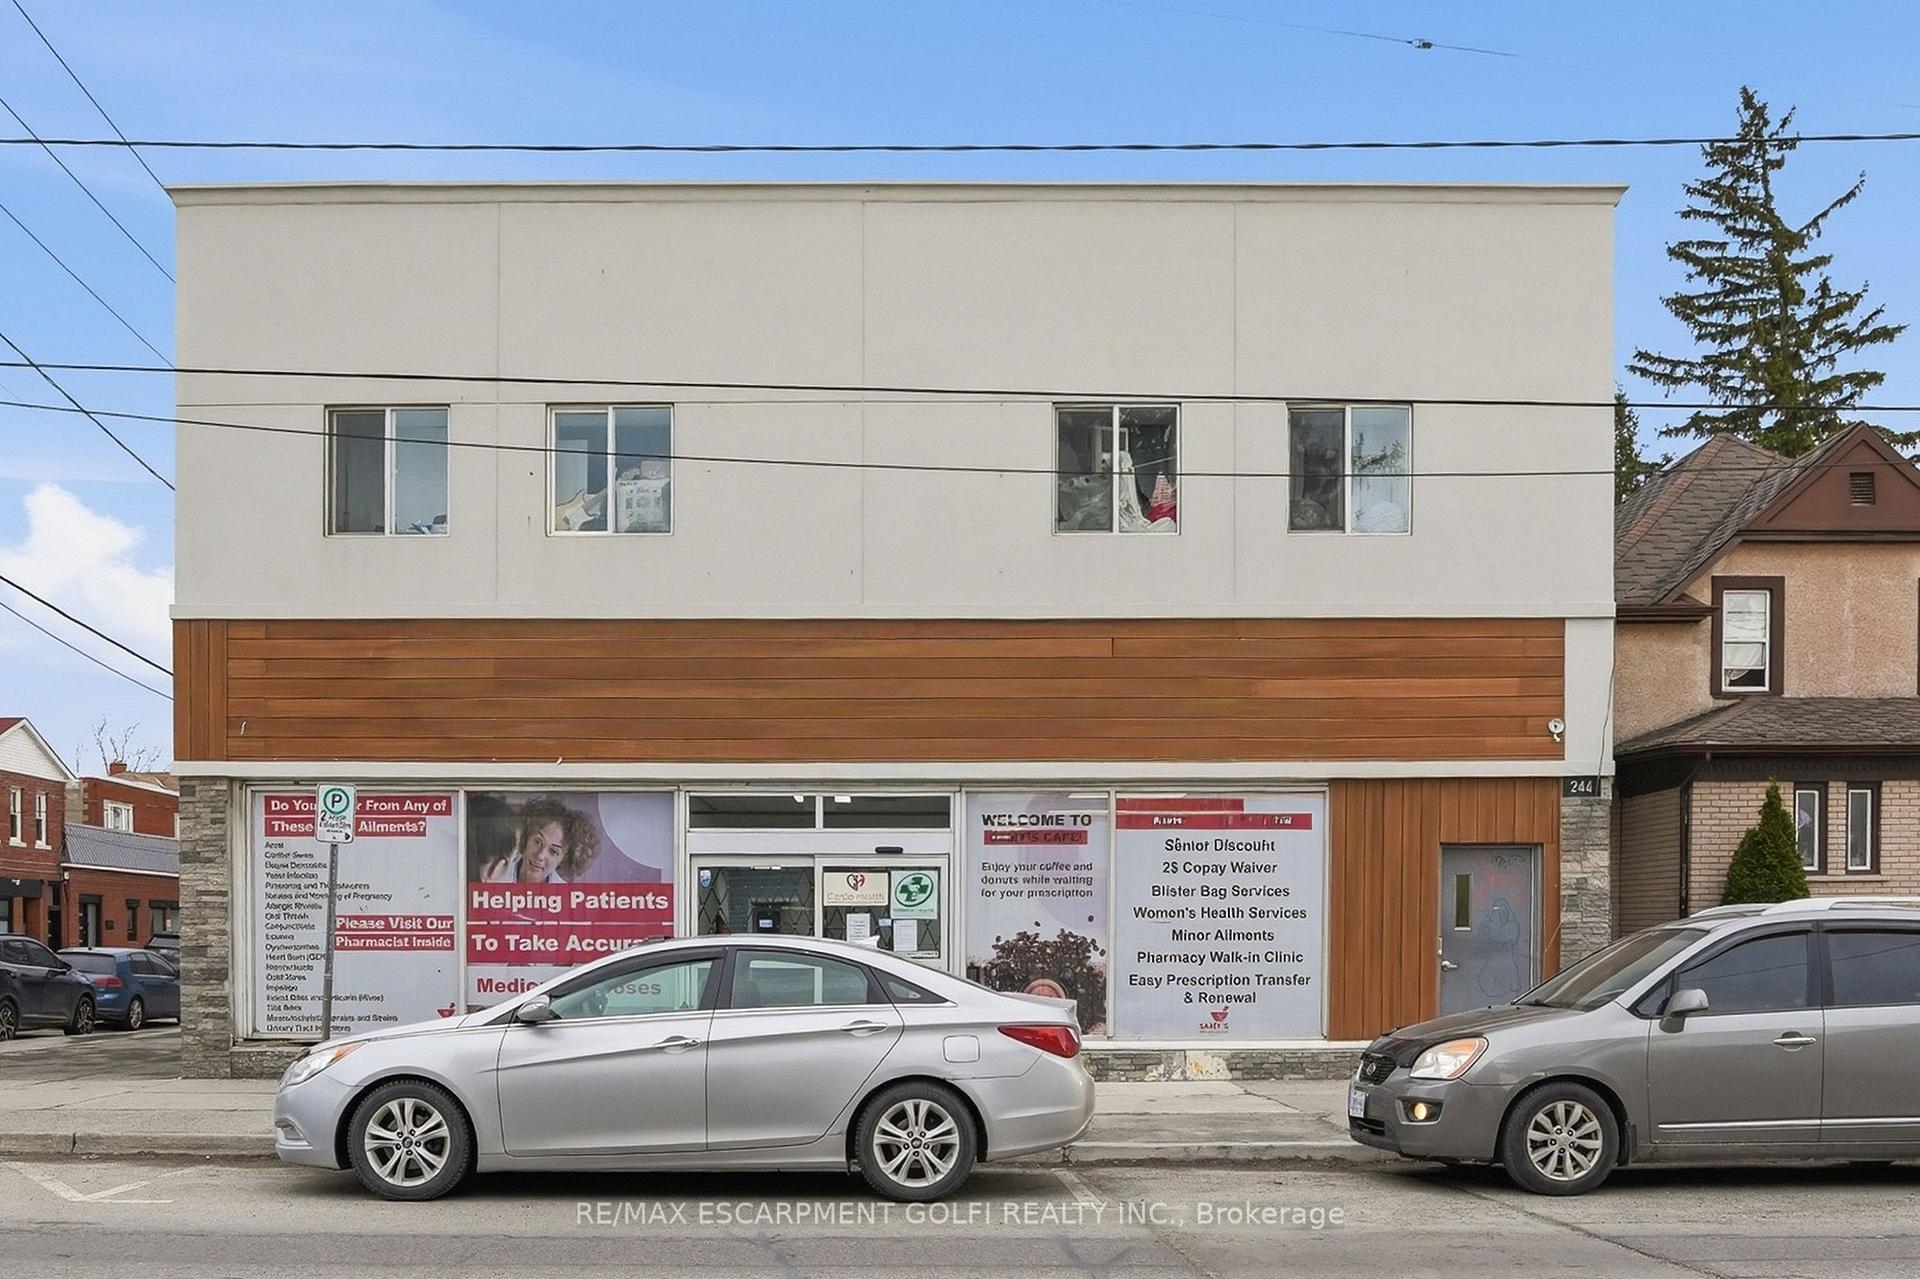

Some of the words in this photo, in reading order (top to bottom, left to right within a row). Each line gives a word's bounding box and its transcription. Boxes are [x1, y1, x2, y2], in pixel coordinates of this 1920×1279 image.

[1570, 780, 1593, 793] 244
[271, 801, 288, 811] Do
[366, 801, 400, 811] From
[403, 800, 430, 814] Any
[433, 800, 447, 811] of
[271, 821, 314, 832] These
[358, 820, 426, 832] Ailments?
[982, 814, 1065, 826] WELCOME
[1069, 814, 1092, 826] TO
[981, 862, 1011, 873] Enjoy
[1014, 863, 1037, 873] your
[1073, 862, 1093, 872] and
[1182, 861, 1227, 876] Copay
[1231, 861, 1278, 874] Waiver
[981, 876, 1019, 885] donuts
[1022, 876, 1051, 885] while
[981, 888, 997, 898] for
[1000, 890, 1024, 900] your
[1151, 885, 1196, 898] Blister
[1200, 885, 1227, 900] Bag
[1231, 885, 1290, 898] Services
[472, 891, 562, 912] Helping
[570, 891, 669, 910] Patients
[1248, 906, 1307, 919] Services
[336, 917, 385, 930] Please
[388, 917, 421, 930] Visit
[426, 917, 453, 930] Our
[1171, 928, 1211, 941] Minor
[336, 935, 409, 948] Pharmacist
[412, 935, 451, 948] Inside
[471, 934, 498, 951] To
[505, 934, 559, 951] Take
[1137, 951, 1206, 966] Pharmacy
[1209, 951, 1260, 963] Walk-in
[1264, 951, 1304, 963] Clinic
[1129, 974, 1163, 989] Easy
[1167, 974, 1250, 989] Prescription
[1255, 974, 1311, 986] Transfer
[1183, 992, 1193, 1004] &
